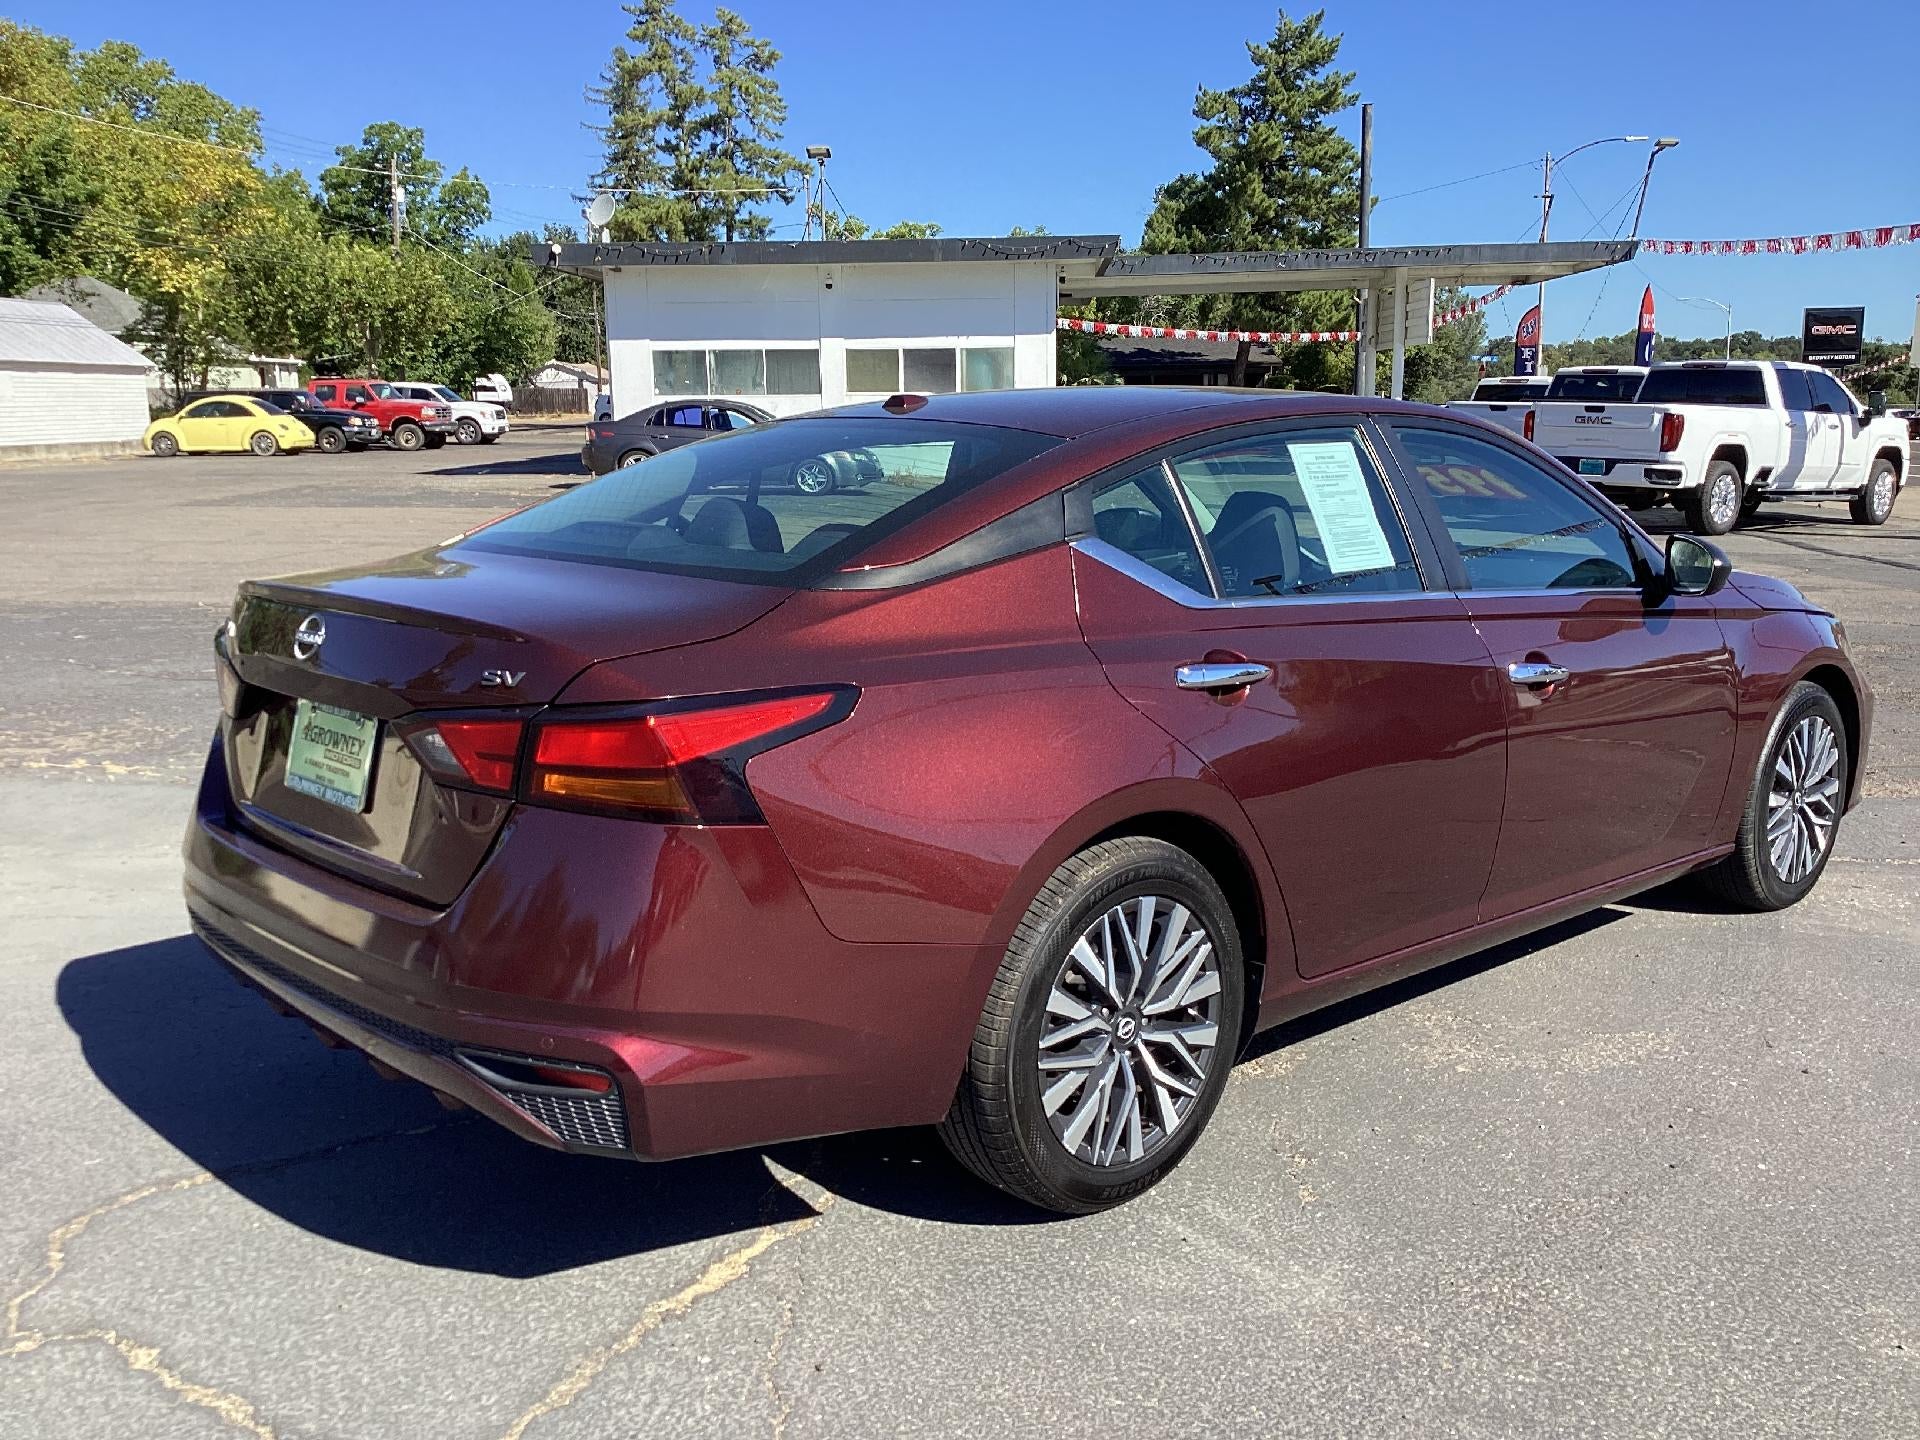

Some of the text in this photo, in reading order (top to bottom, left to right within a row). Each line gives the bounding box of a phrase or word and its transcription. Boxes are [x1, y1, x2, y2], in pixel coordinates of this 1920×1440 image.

[1811, 324, 1857, 335] GMC
[1574, 415, 1613, 425] GMC
[480, 668, 527, 688] SV
[325, 749, 362, 769] MOTORS
[1089, 871, 1136, 907] PREMIER
